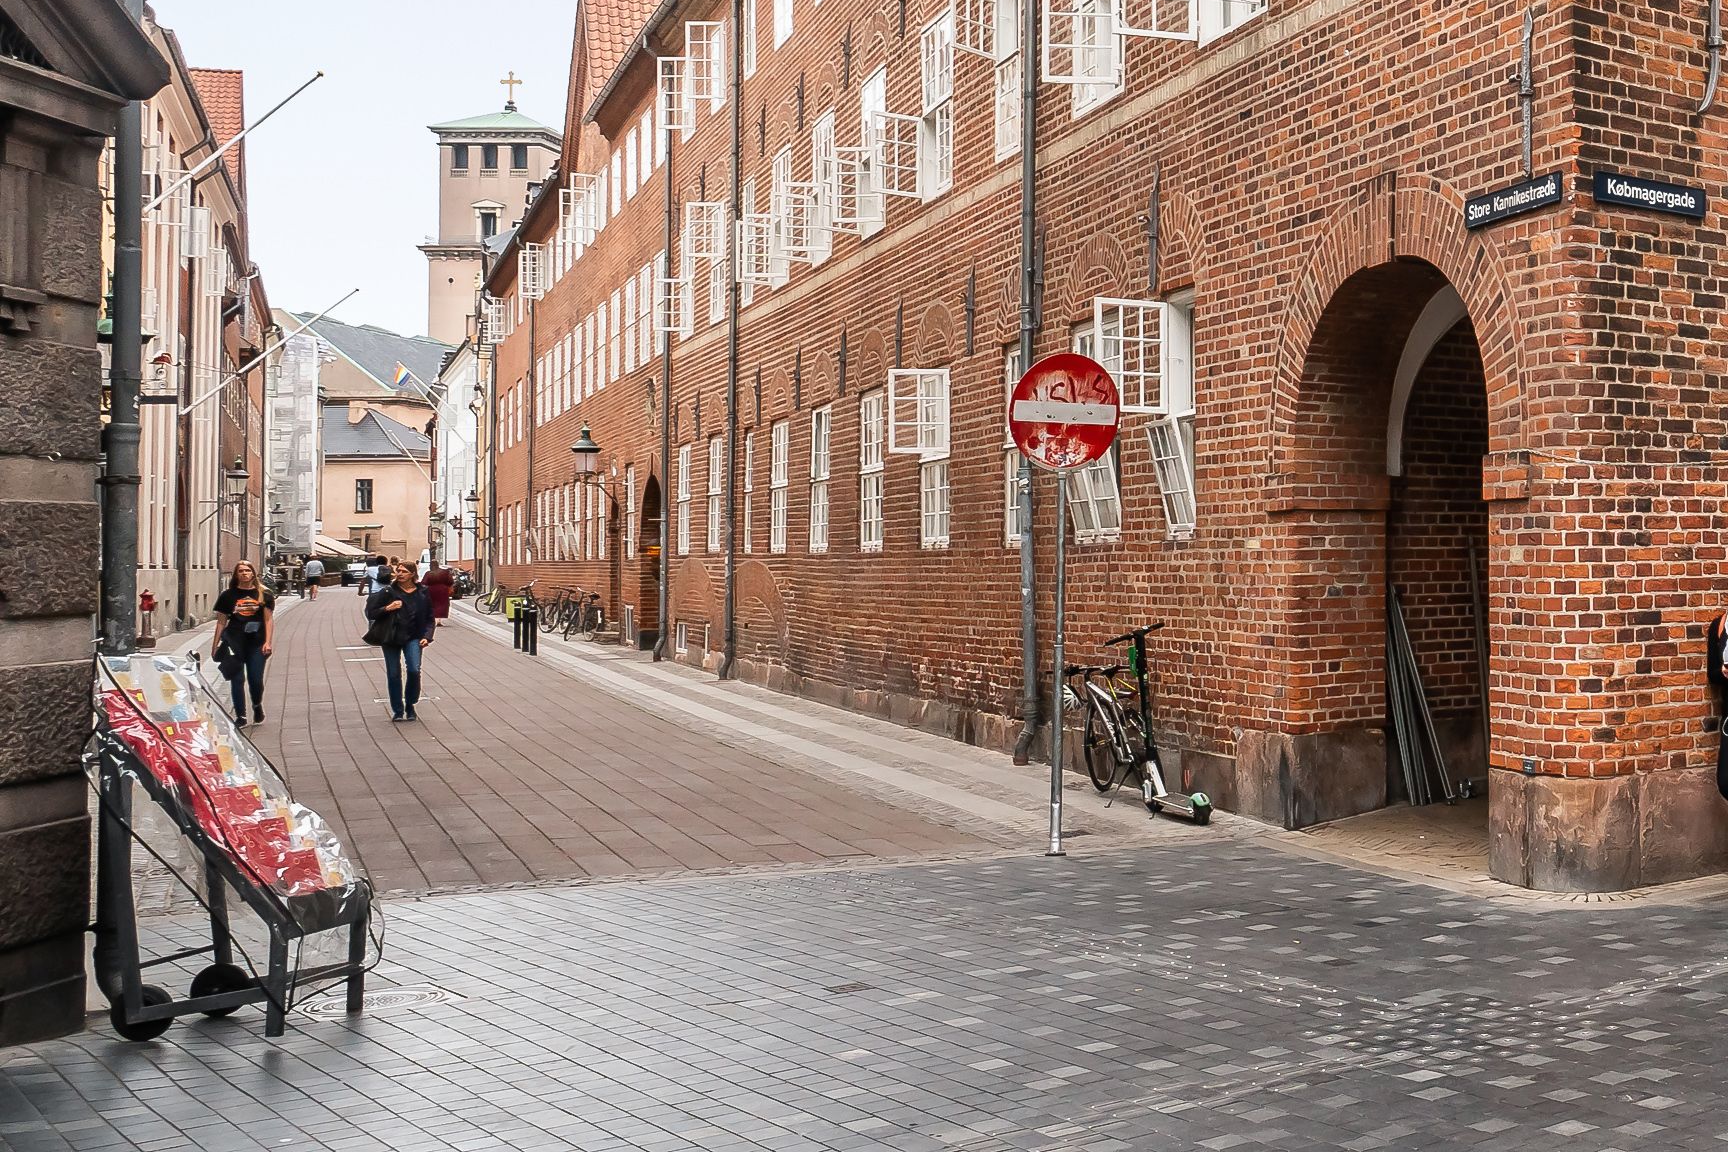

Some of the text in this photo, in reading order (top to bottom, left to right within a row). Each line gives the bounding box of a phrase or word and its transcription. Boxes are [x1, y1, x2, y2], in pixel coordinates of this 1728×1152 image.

[1468, 179, 1556, 221] Store Kannikestræde
[1607, 178, 1696, 209] Købmagergade
